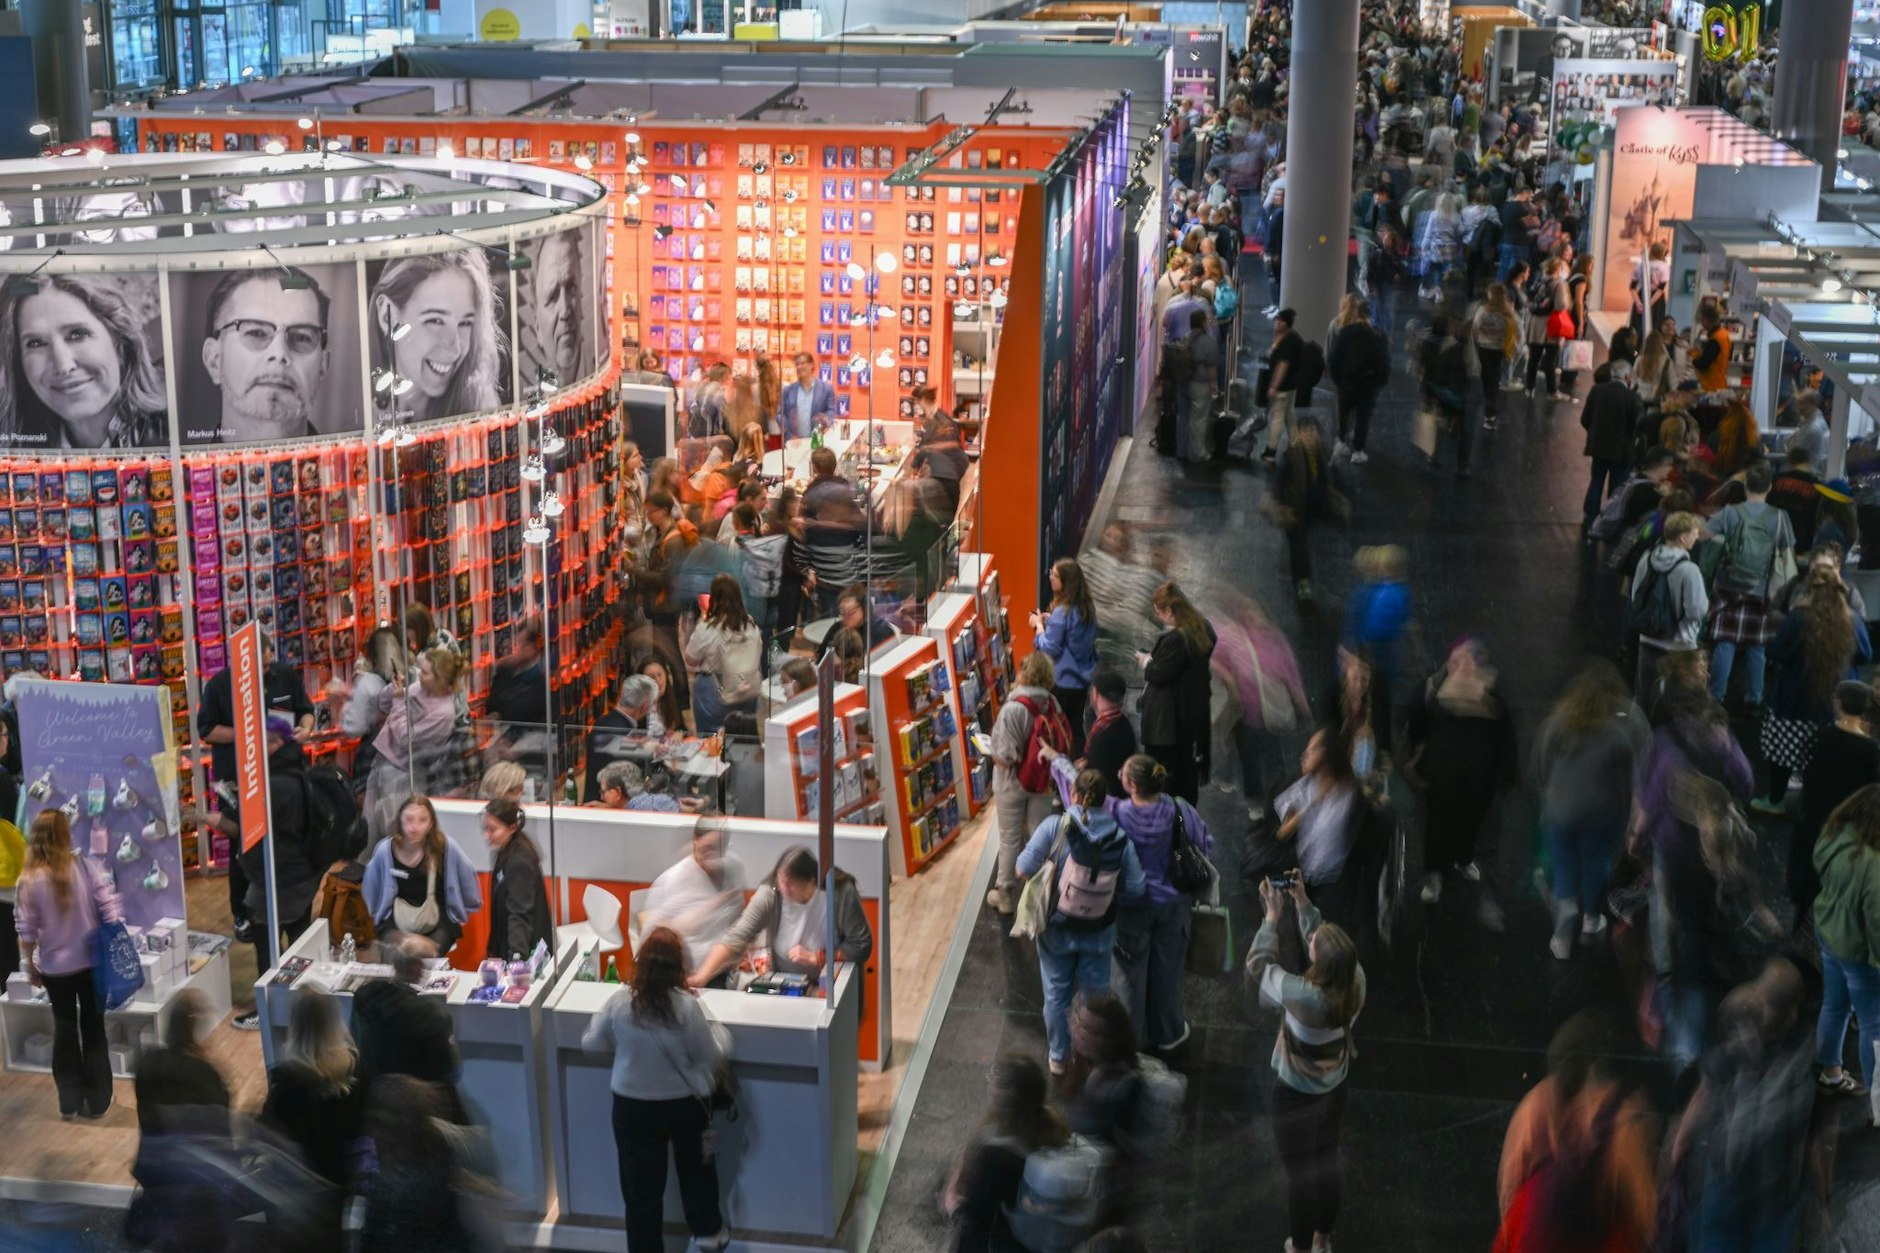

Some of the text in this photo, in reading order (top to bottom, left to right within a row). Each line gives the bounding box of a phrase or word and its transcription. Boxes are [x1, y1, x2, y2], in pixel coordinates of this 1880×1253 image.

[1620, 142, 1654, 155] Castle
[1656, 144, 1668, 154] of
[11, 432, 48, 442] Poznanski
[187, 429, 215, 439] Markus
[46, 708, 119, 728] Welcome
[238, 636, 259, 801] Information
[37, 720, 157, 749] Green Valley
